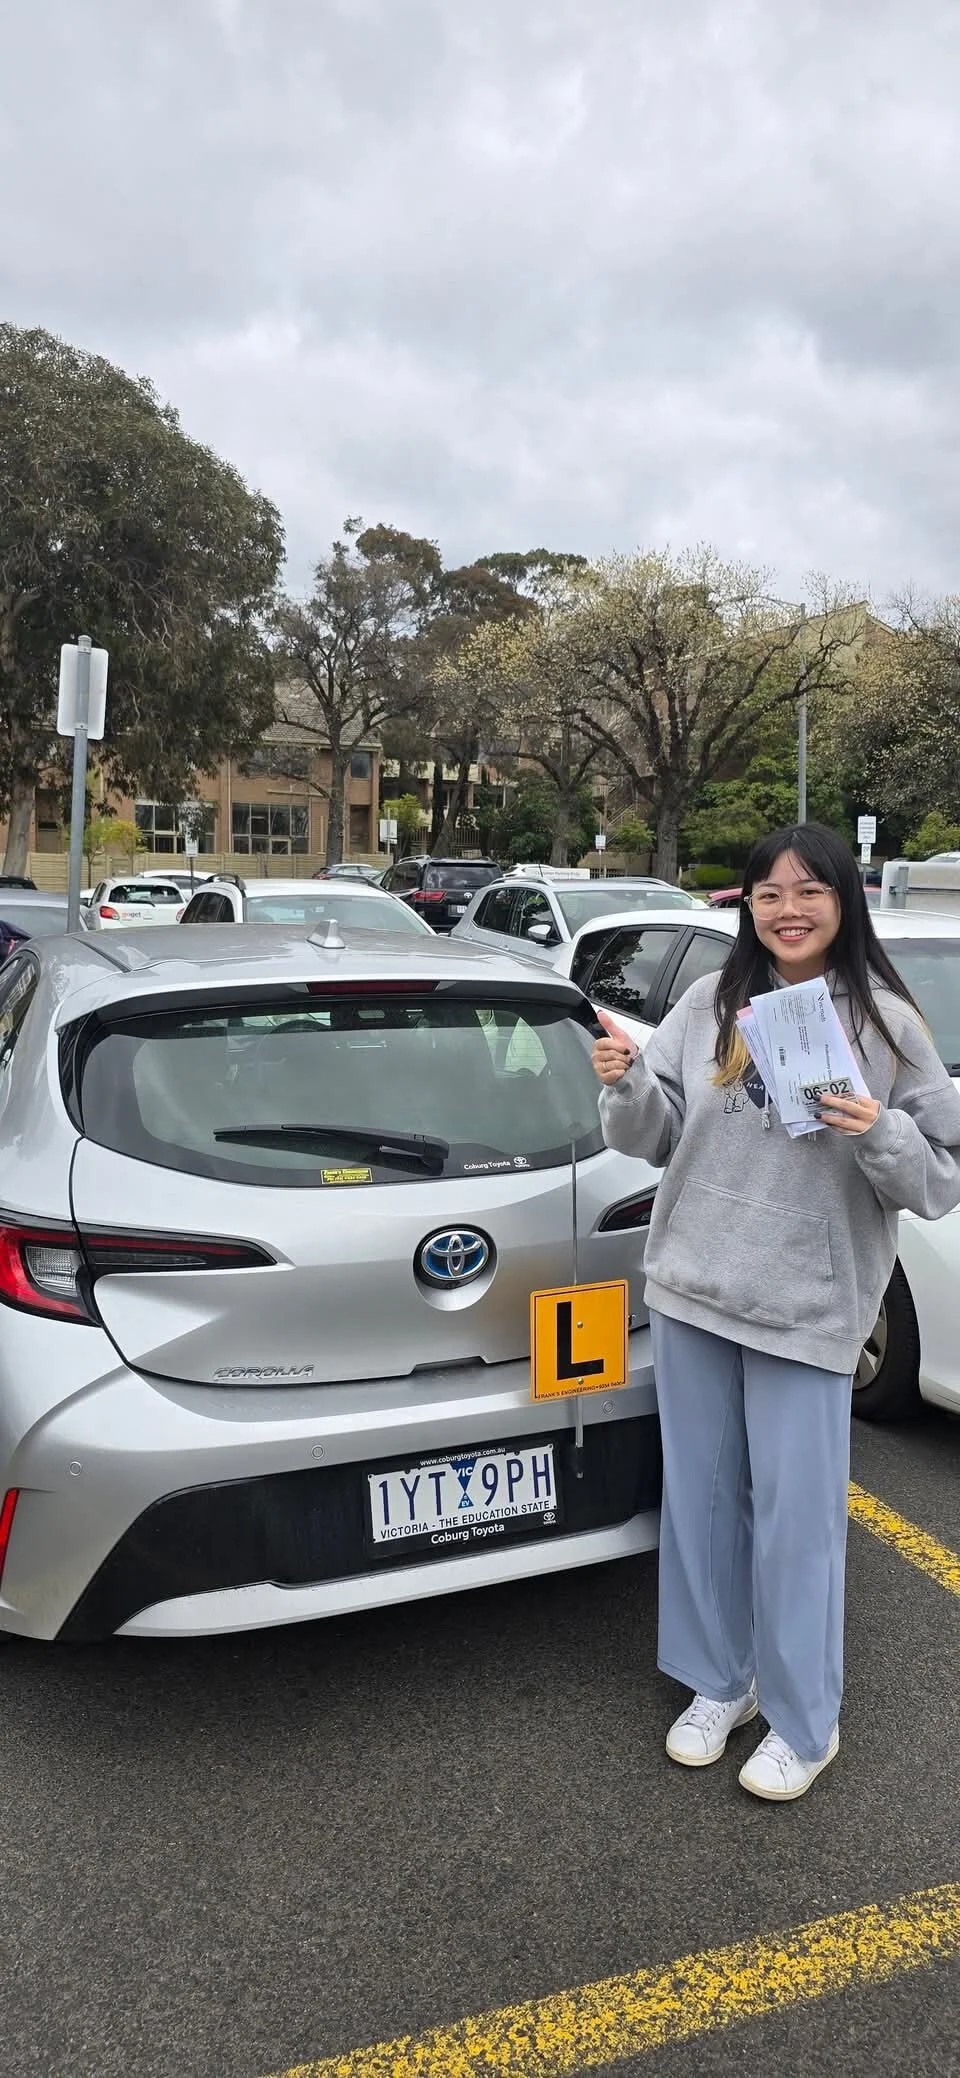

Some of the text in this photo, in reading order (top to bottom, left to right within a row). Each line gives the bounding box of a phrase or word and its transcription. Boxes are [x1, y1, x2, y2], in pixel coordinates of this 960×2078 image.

[556, 1301, 604, 1381] L
[213, 1364, 315, 1381] COROLLA
[420, 1448, 506, 1466] www.coburgtoyota.com.au
[380, 1522, 429, 1540] VICTORIA
[439, 1517, 459, 1529] THE
[462, 1506, 518, 1526] EDUCATION
[521, 1500, 550, 1513] STATE
[430, 1523, 505, 1545] Coburg Toyota
